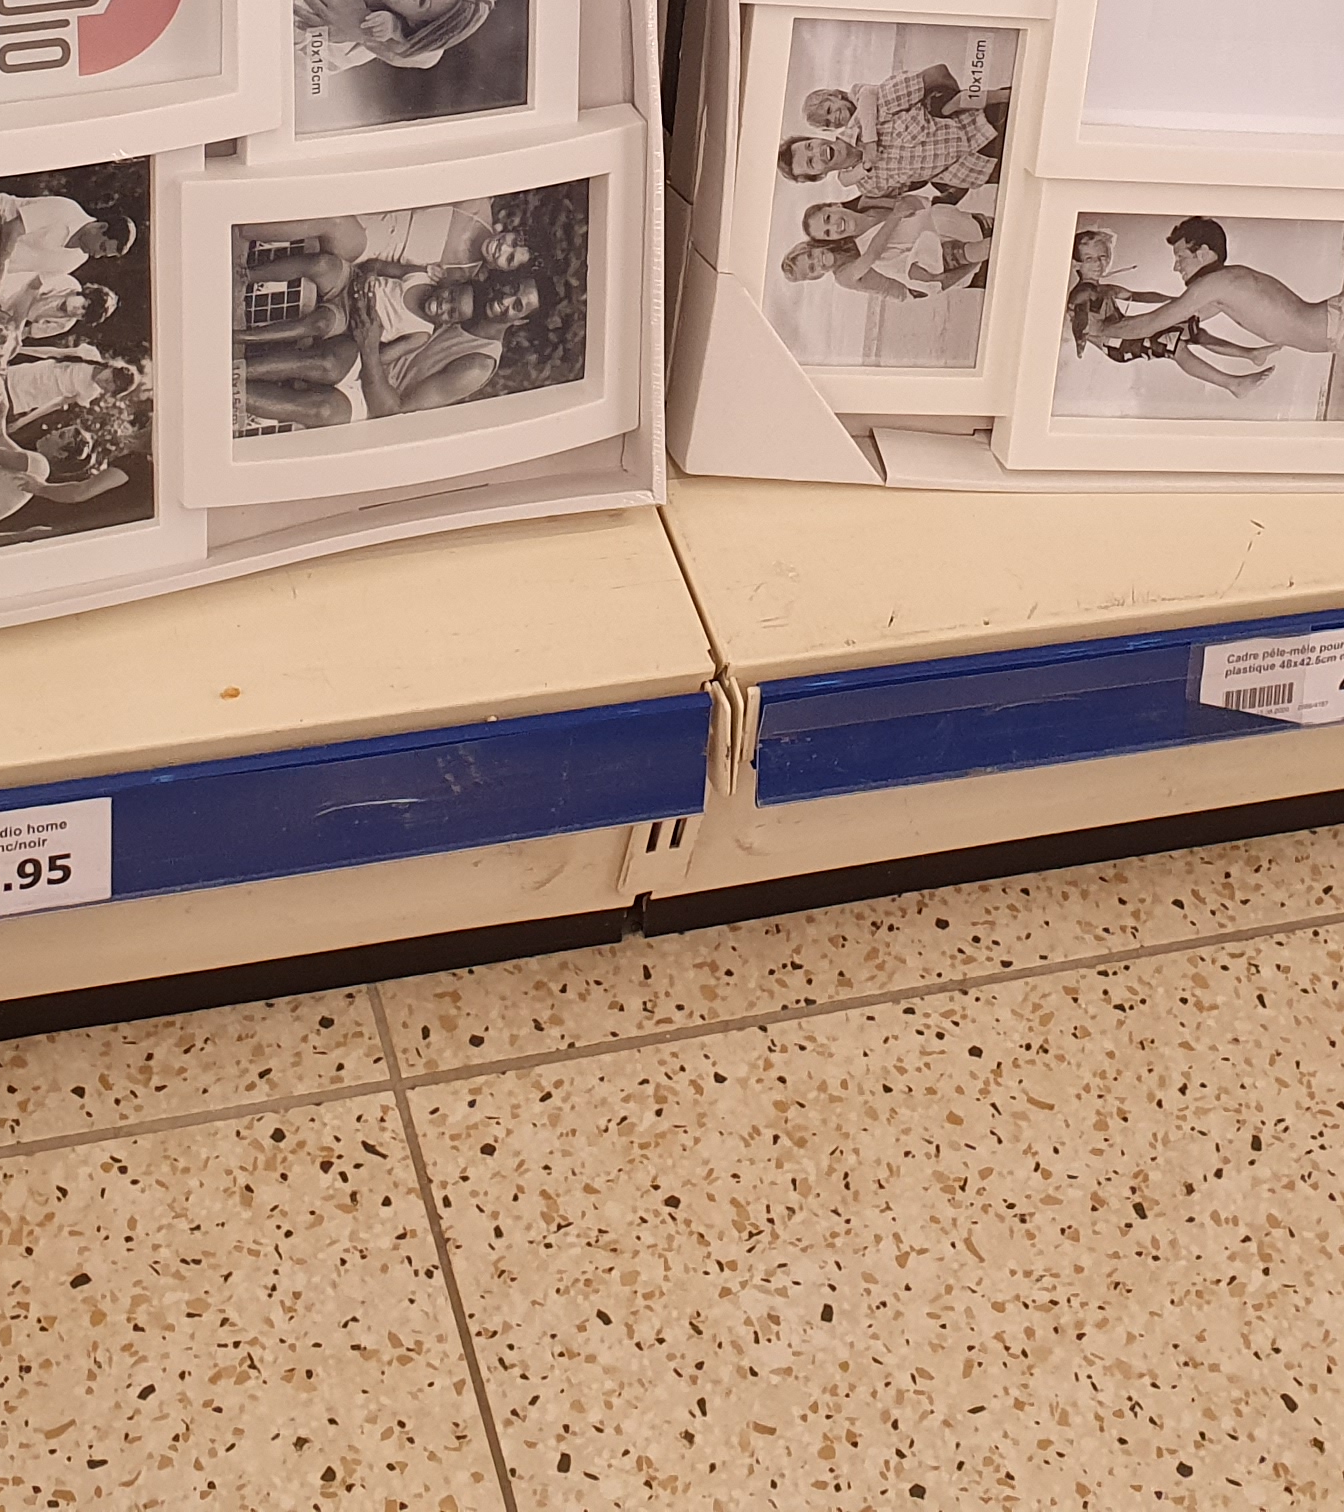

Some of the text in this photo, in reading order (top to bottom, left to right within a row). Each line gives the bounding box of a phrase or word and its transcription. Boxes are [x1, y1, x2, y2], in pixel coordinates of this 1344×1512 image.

[311, 31, 322, 95] 10x15cm
[968, 38, 987, 101] 10x15cm
[1227, 652, 1259, 664] Cadre
[1319, 641, 1344, 654] pour
[1225, 663, 1276, 679] plastique
[27, 820, 68, 835] home
